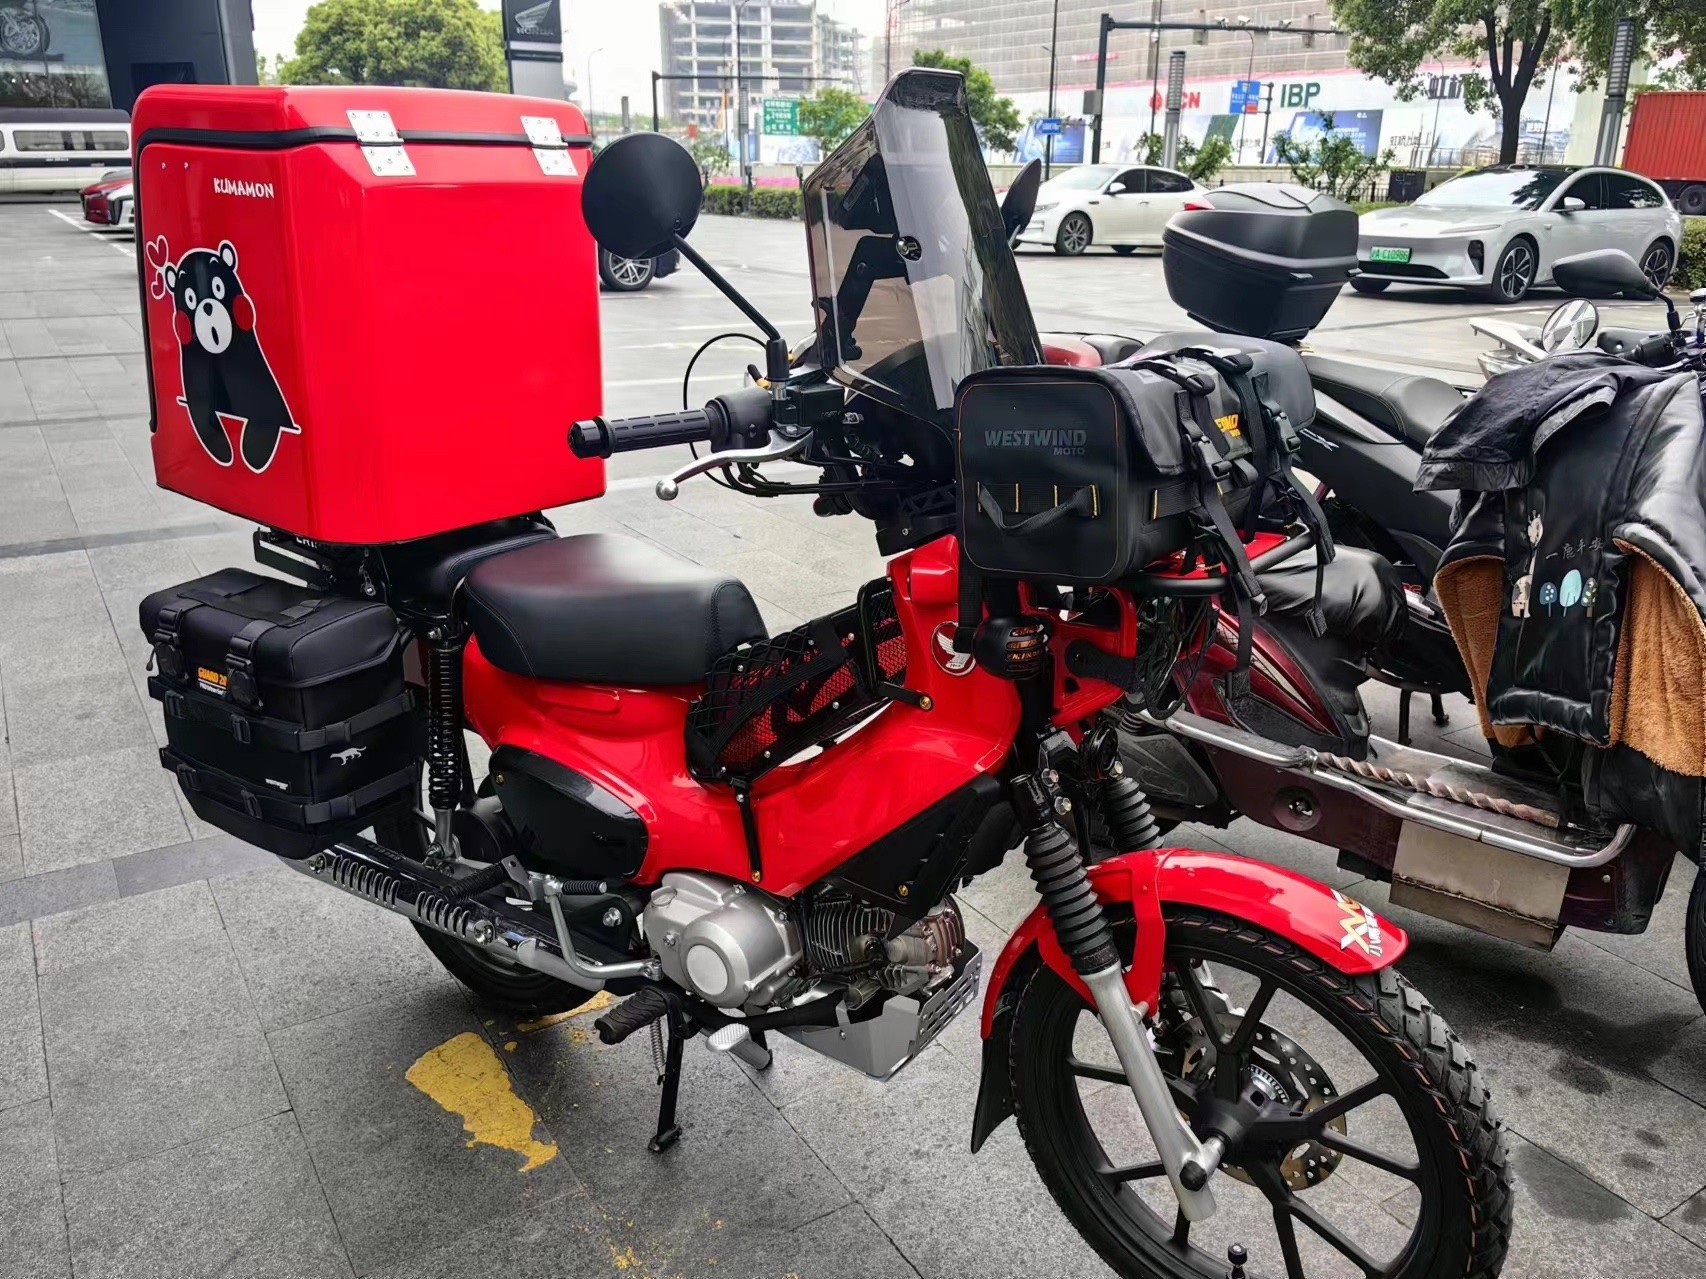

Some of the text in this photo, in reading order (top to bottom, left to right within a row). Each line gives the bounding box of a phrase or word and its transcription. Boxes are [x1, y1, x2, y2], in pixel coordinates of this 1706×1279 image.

[1280, 82, 1321, 109] IBP
[213, 177, 275, 199] KUMAMON
[984, 429, 1087, 447] WESTWIND
[1053, 446, 1085, 456] MOTO
